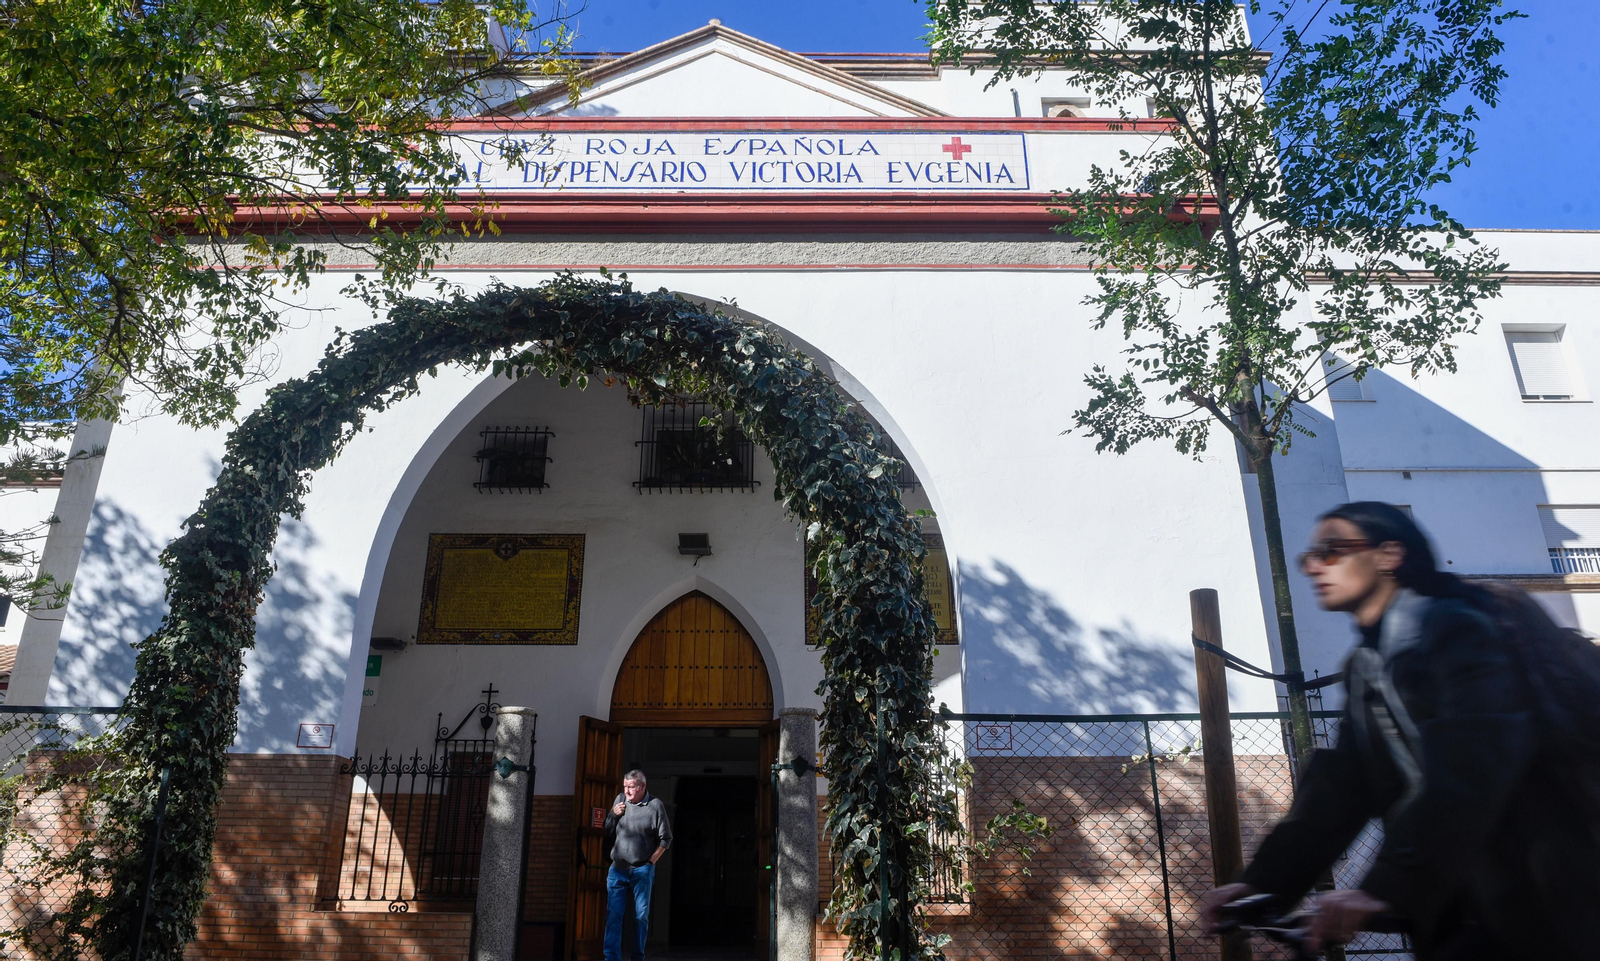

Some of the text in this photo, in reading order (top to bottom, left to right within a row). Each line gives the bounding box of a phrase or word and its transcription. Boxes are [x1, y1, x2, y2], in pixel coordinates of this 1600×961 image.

[585, 138, 677, 155] ROJA
[703, 136, 881, 156] ESPAÑOLA
[523, 160, 1016, 184] DISPENSARIO VICTORIA EVGENIA
